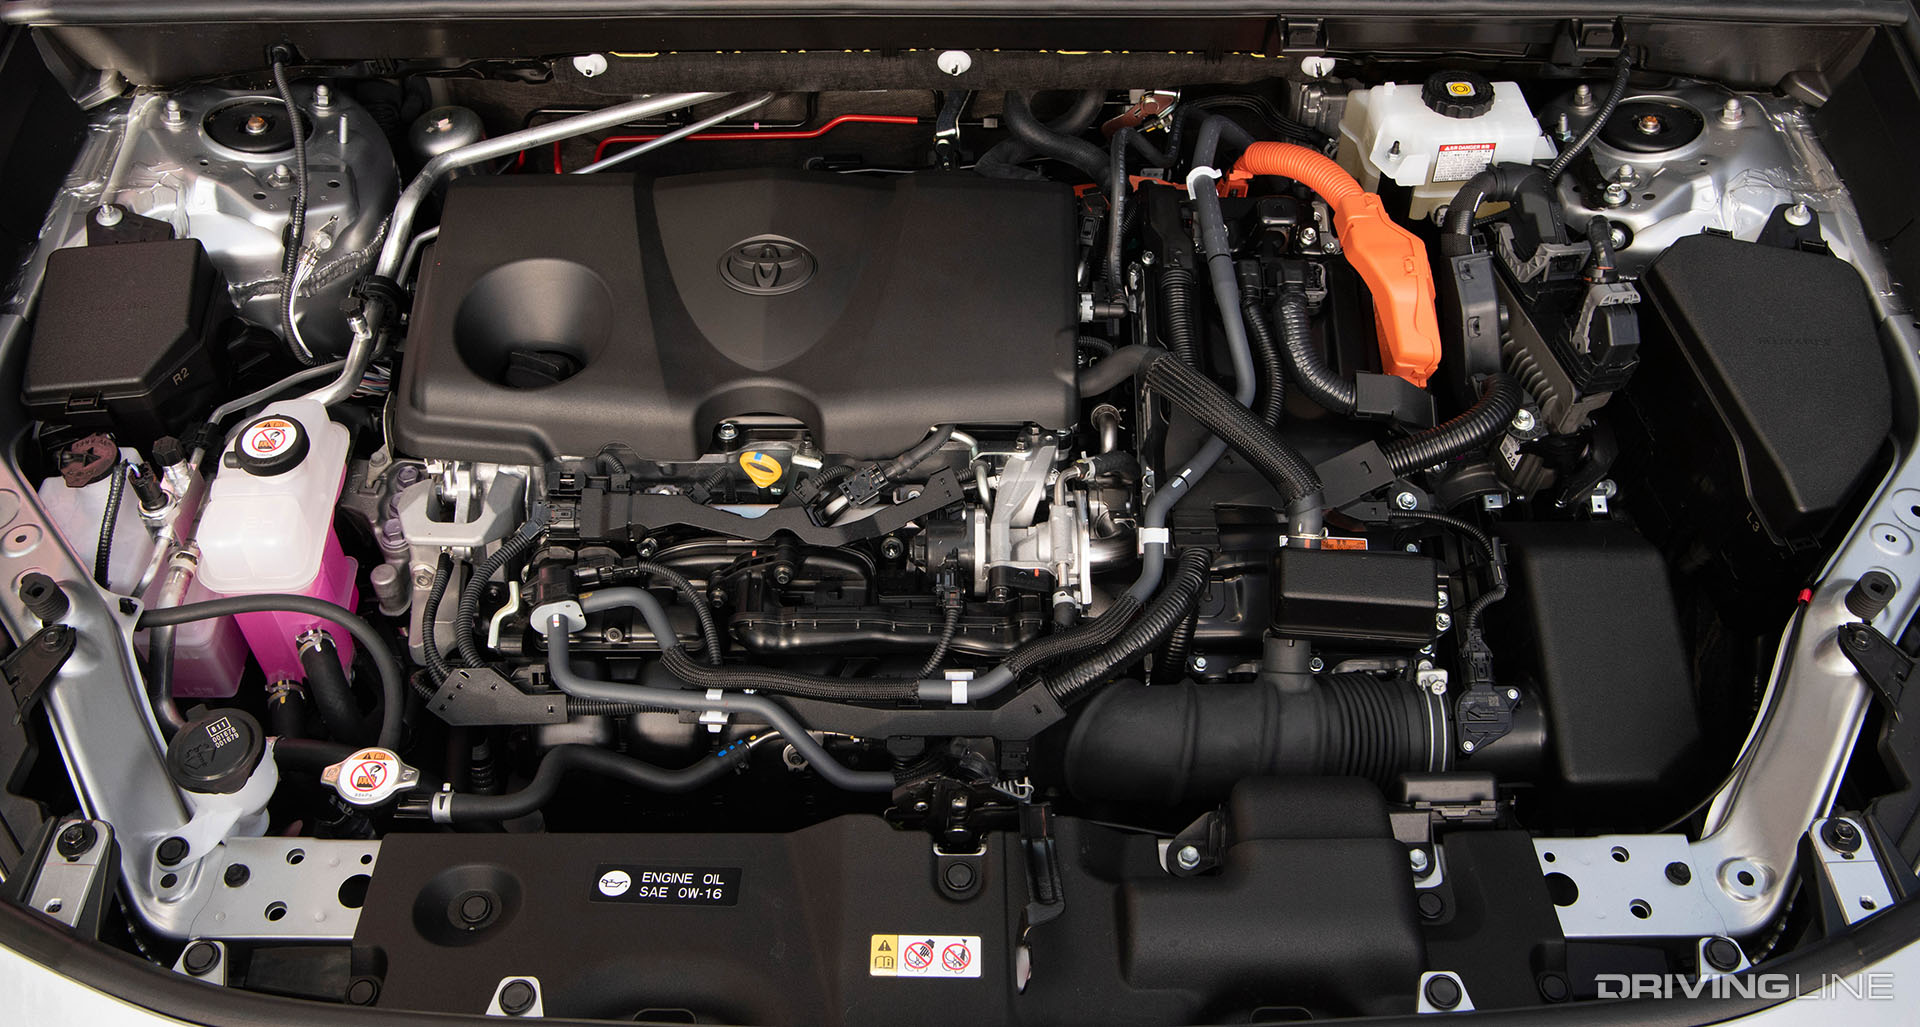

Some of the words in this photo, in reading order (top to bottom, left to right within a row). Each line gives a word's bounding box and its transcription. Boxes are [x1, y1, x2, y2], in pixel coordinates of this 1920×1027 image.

[172, 367, 190, 386] R2
[641, 871, 694, 884] ENGINE
[702, 873, 725, 885] OIL
[639, 886, 669, 898] SAE
[677, 887, 723, 899] 0W-16
